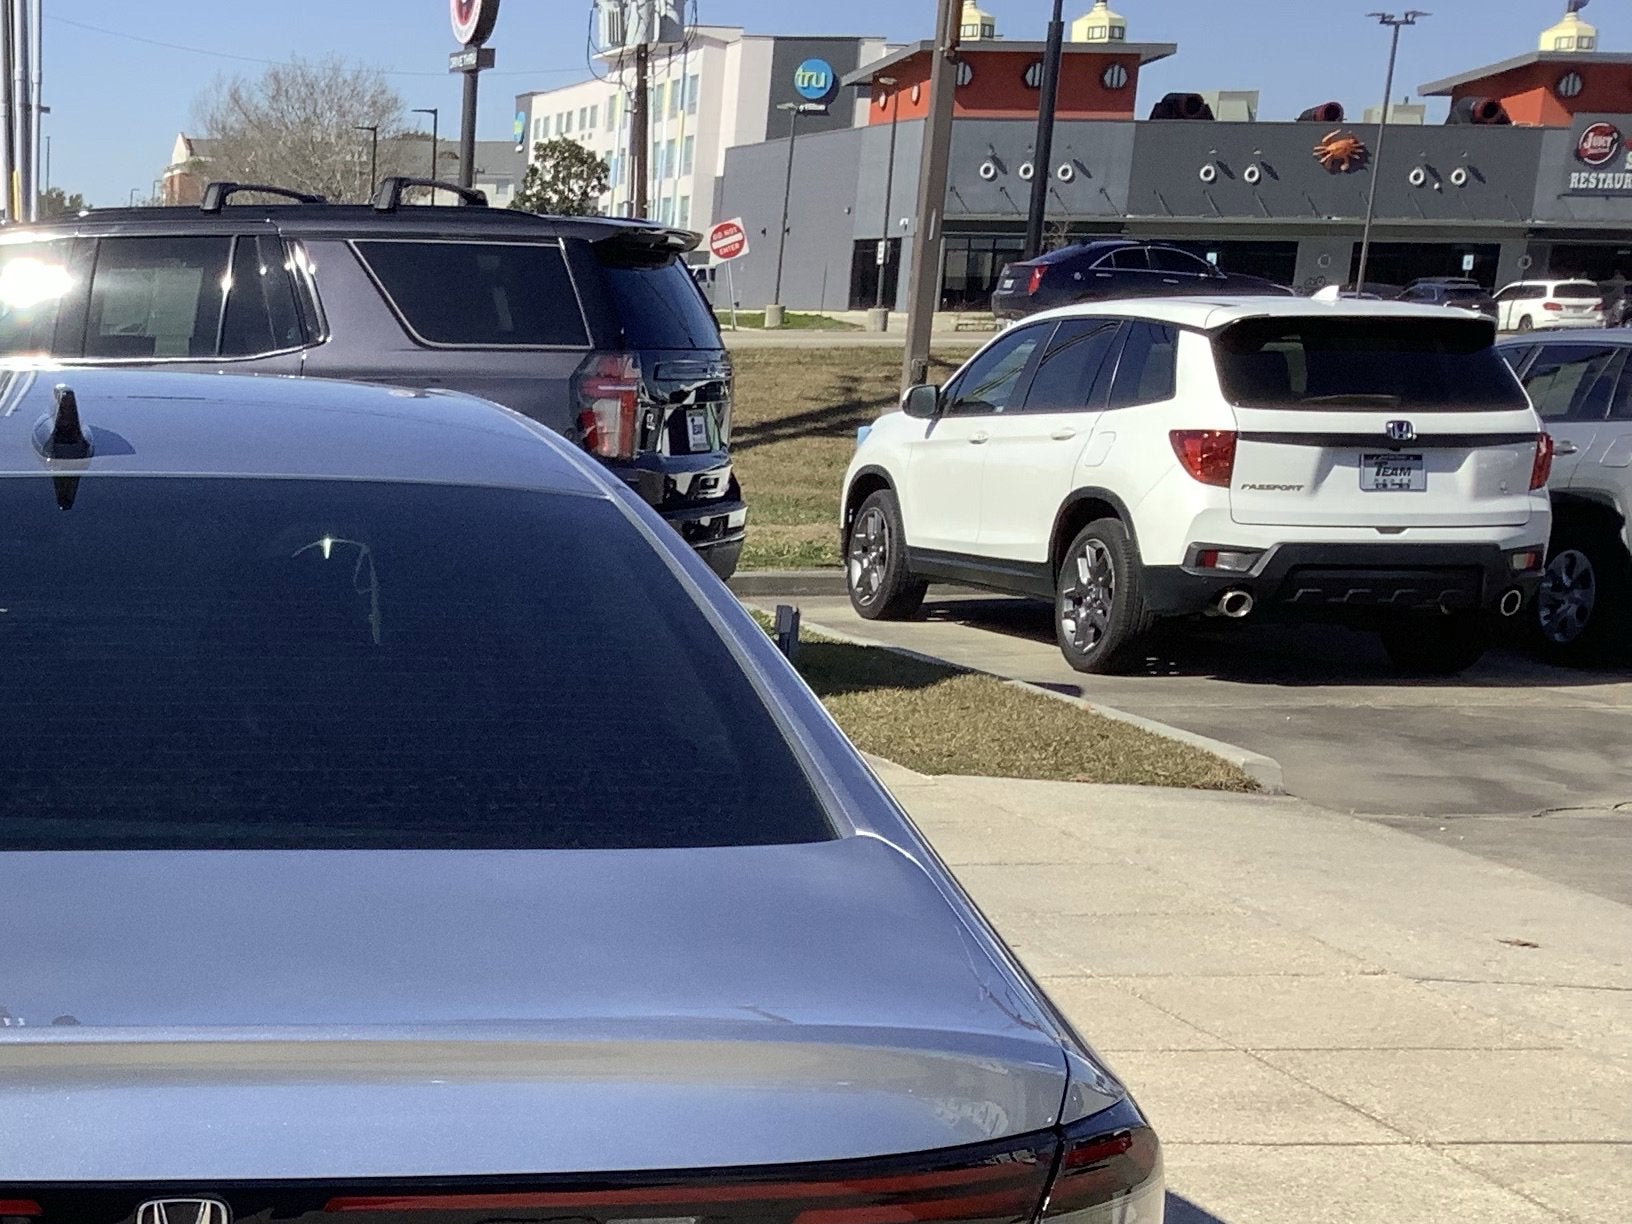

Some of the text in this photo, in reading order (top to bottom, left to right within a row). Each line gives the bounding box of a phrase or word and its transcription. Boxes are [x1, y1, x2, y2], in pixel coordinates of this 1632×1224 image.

[798, 69, 826, 88] tru
[713, 227, 737, 240] DO NOT
[719, 242, 740, 255] ENTER
[1240, 483, 1304, 492] PASSPORT
